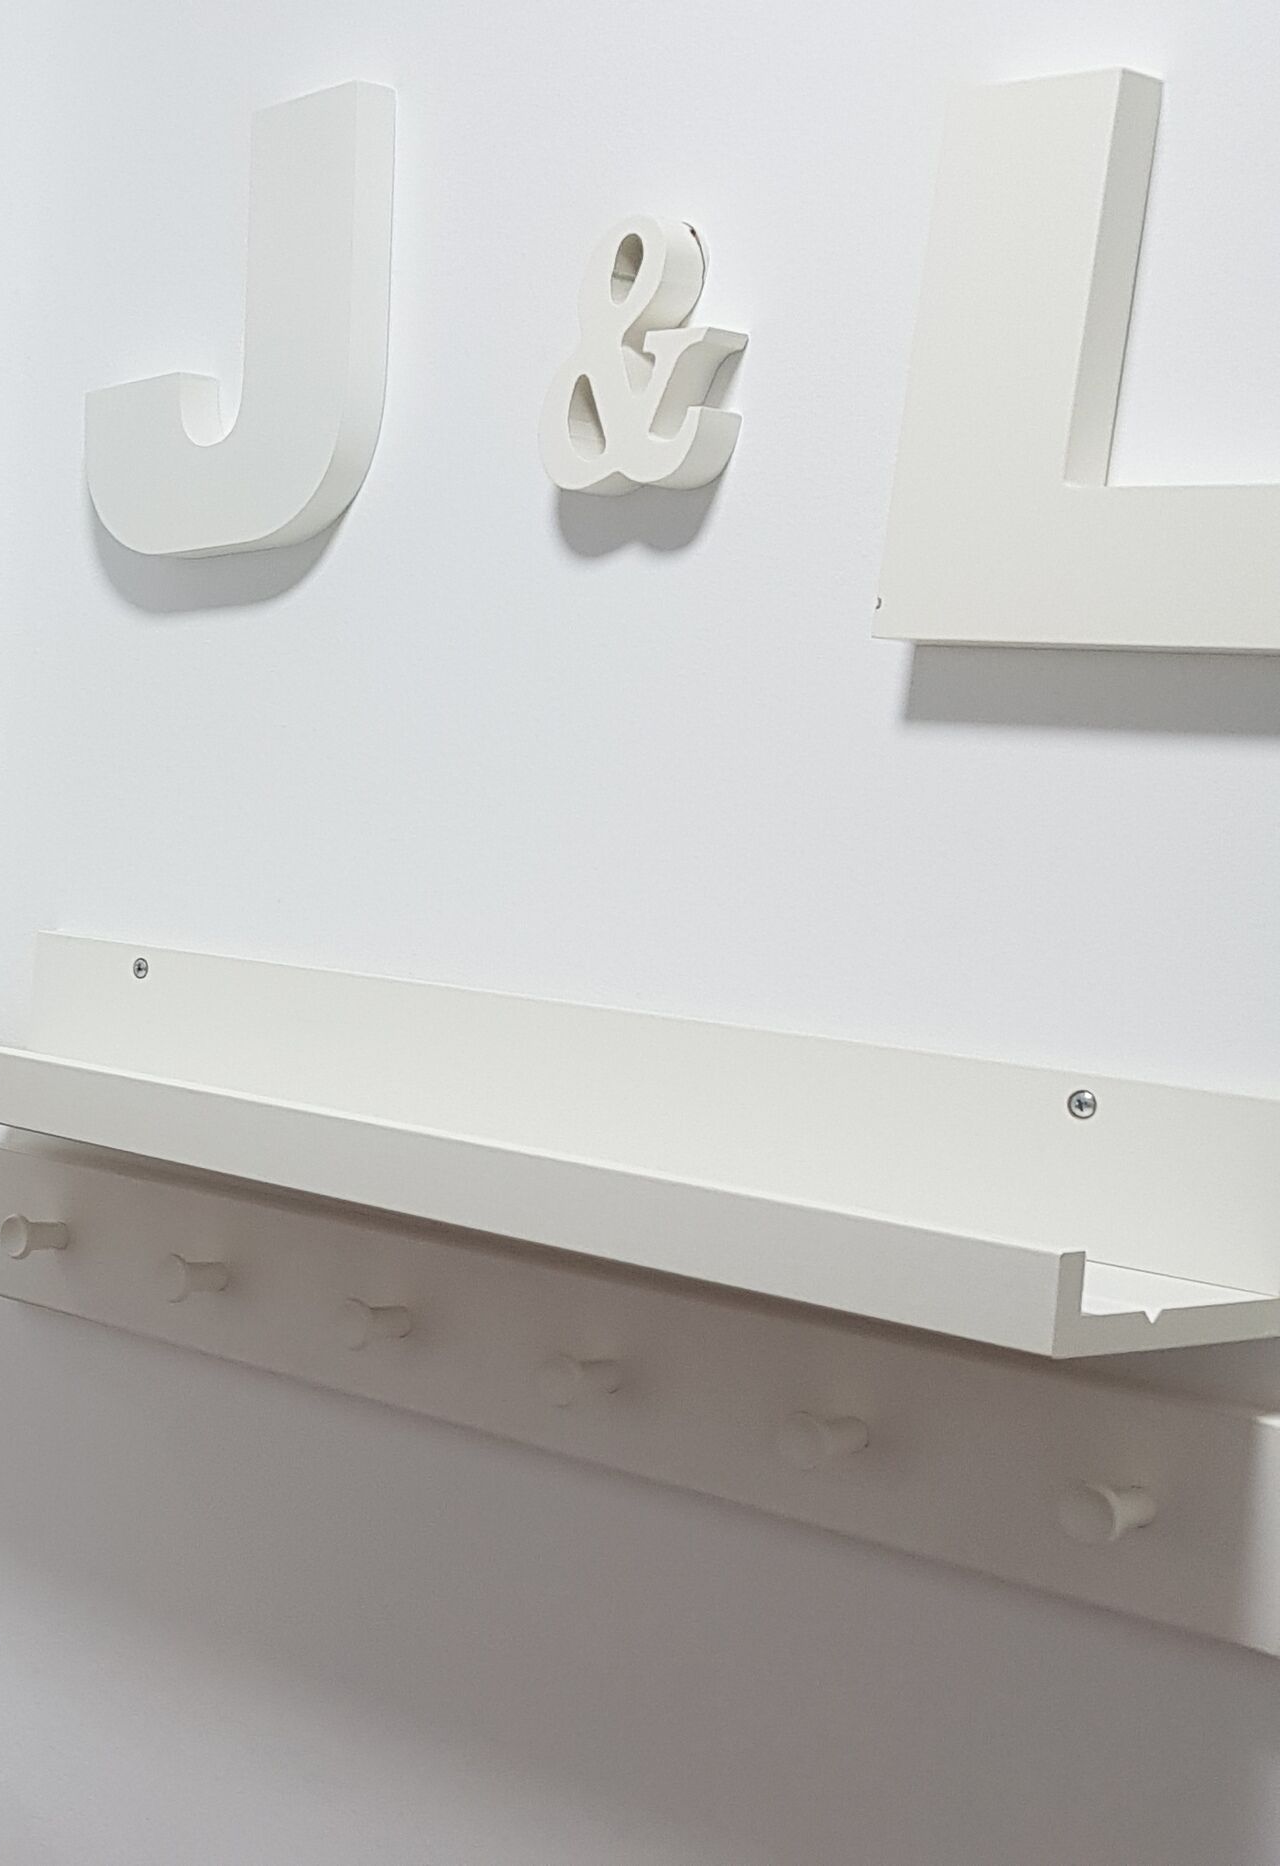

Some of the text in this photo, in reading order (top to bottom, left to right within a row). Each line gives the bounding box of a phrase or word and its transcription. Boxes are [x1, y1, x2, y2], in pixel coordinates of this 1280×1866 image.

[85, 67, 1280, 655] J & L
